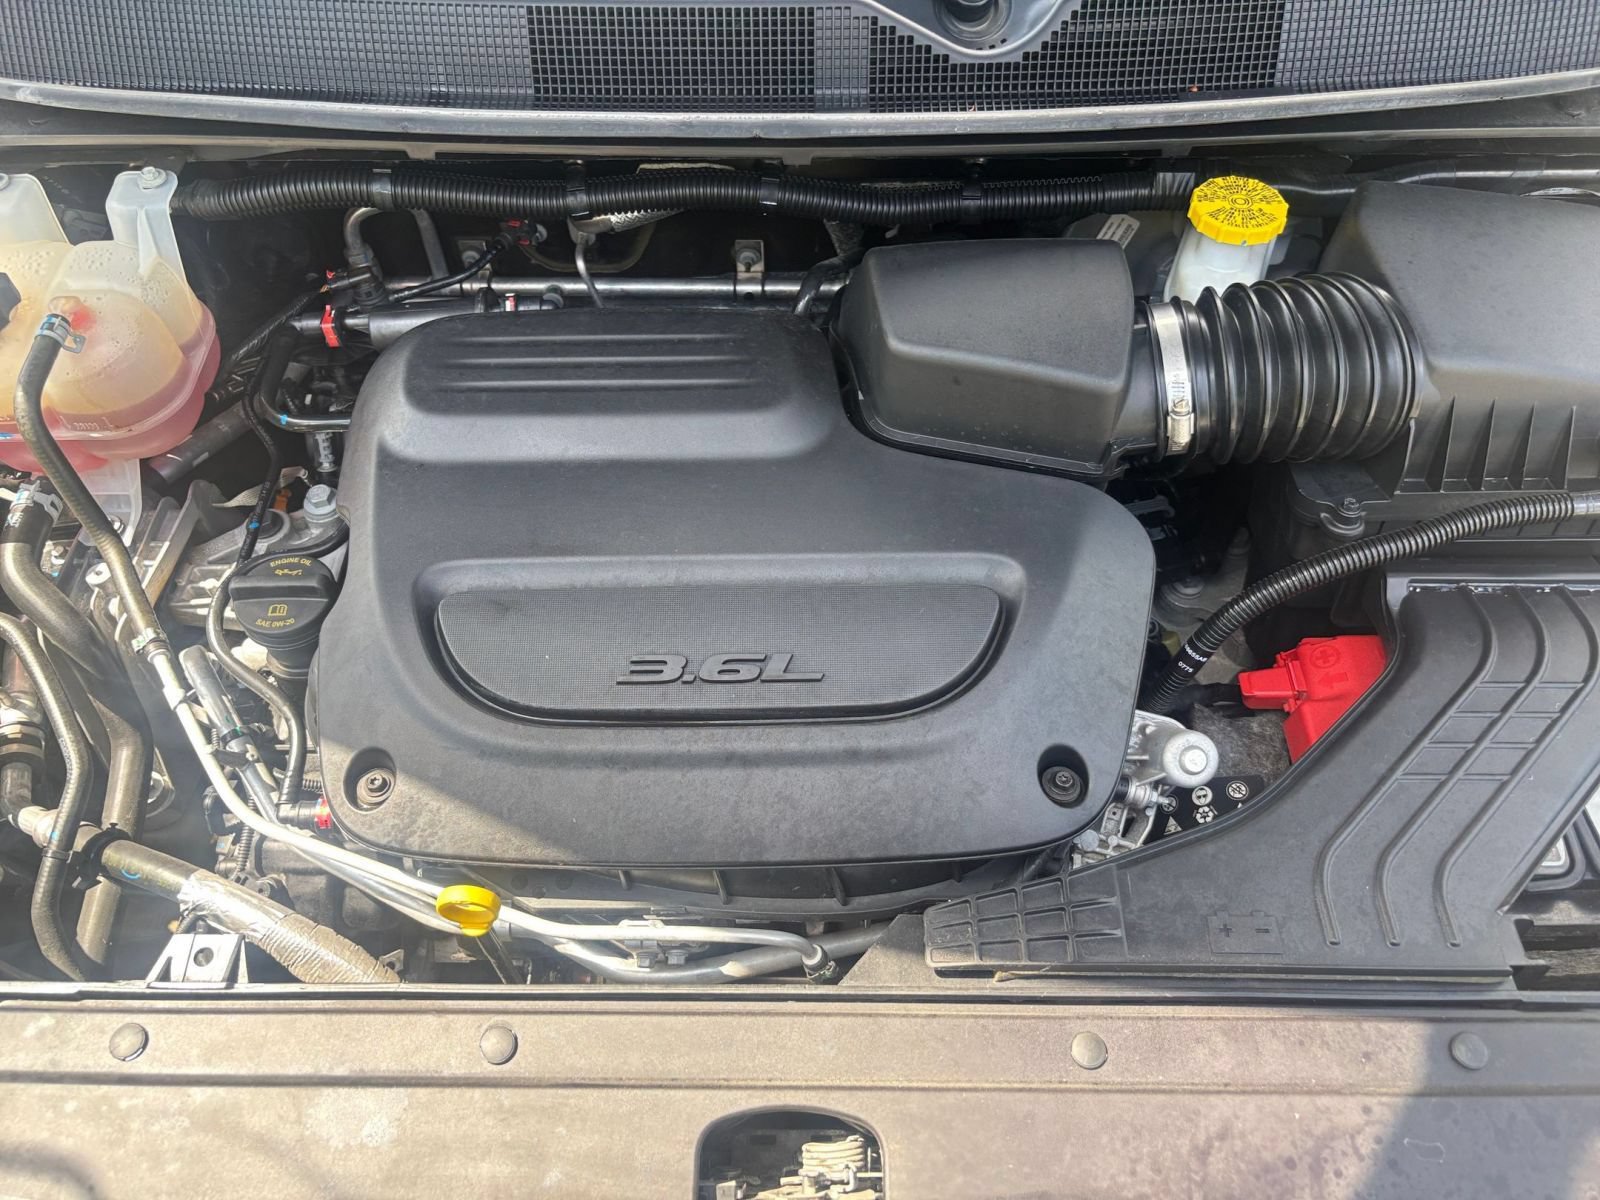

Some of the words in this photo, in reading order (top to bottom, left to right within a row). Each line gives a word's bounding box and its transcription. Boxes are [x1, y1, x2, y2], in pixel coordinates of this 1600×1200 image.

[270, 557, 299, 567] ENGINE
[300, 558, 312, 566] OIL
[256, 618, 270, 627] SAE
[616, 653, 825, 686] 3.6L
